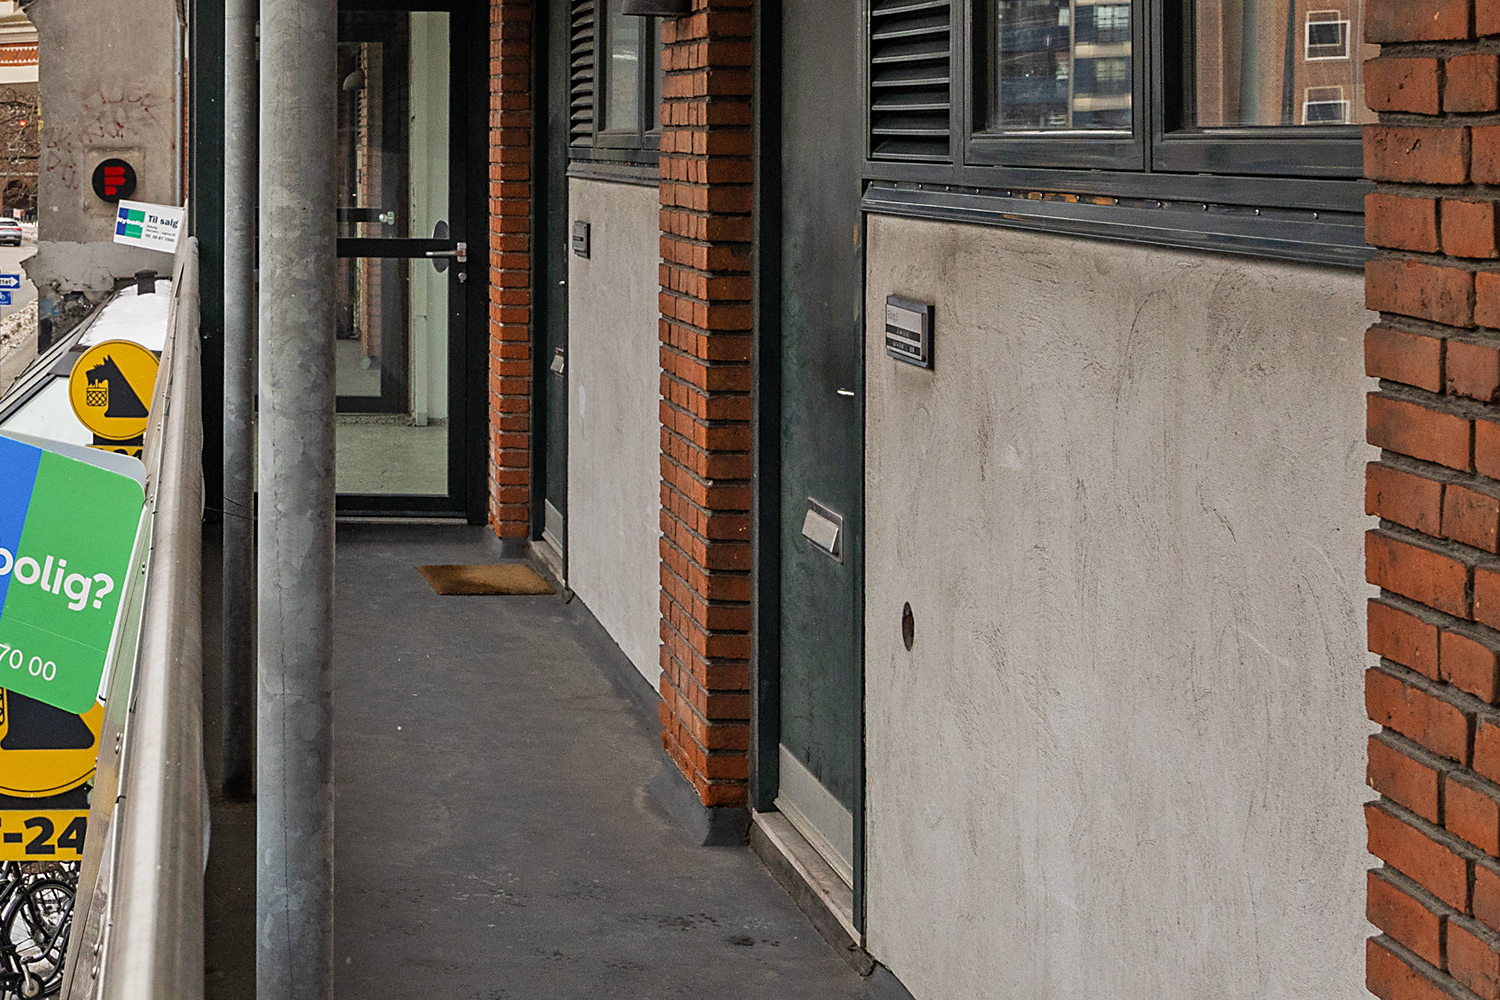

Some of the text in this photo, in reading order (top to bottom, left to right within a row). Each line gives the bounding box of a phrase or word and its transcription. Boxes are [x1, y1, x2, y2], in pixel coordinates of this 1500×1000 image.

[148, 214, 158, 224] Til
[160, 217, 179, 229] salg
[28, 654, 57, 682] 00
